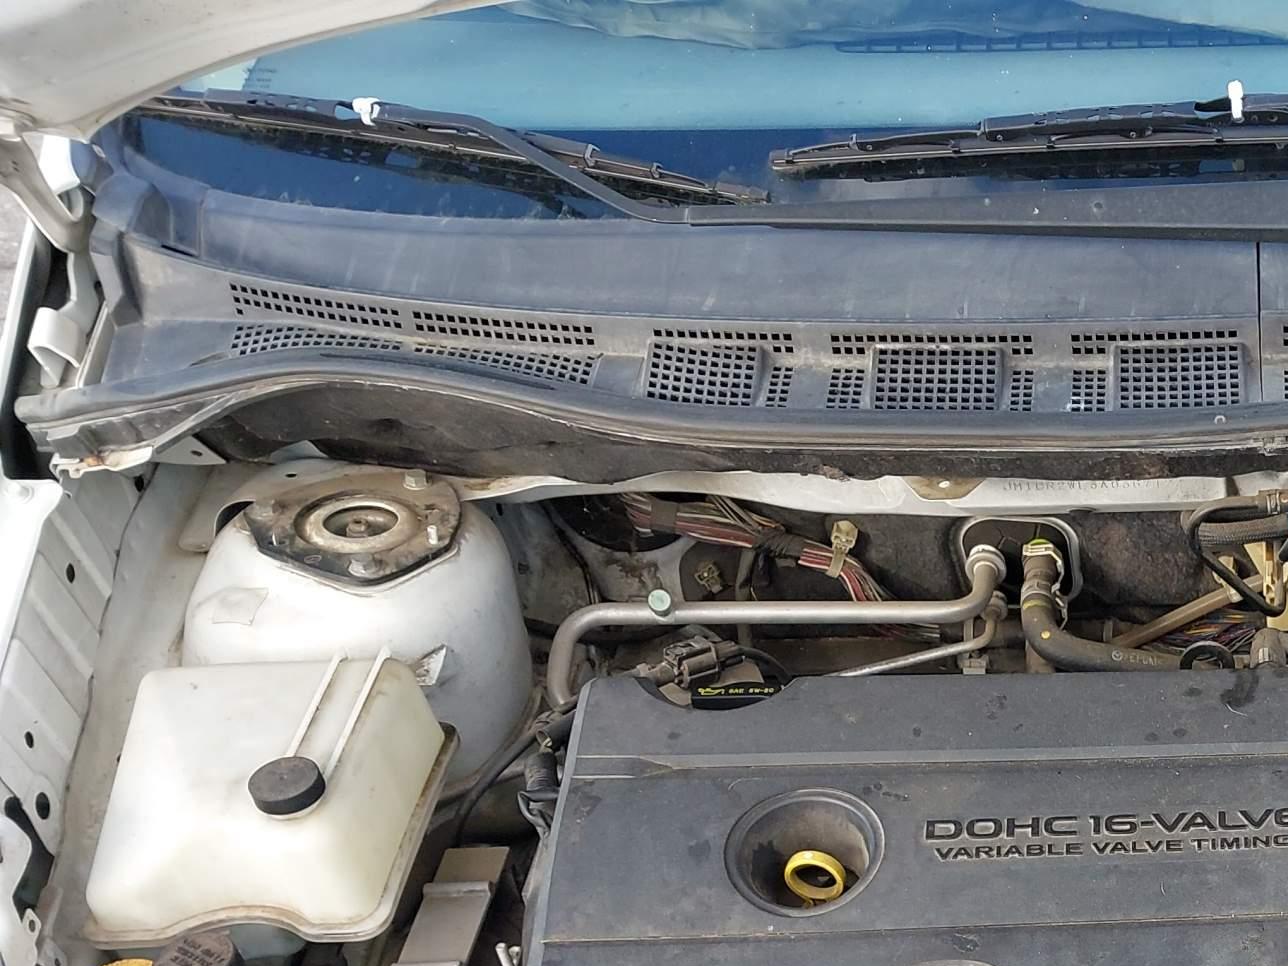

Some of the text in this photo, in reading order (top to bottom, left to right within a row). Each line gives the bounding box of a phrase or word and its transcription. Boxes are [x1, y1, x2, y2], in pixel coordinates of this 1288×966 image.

[924, 815, 1080, 841] DOHC
[934, 842, 1084, 862] VARIABLE
[1091, 839, 1184, 856] VALVE
